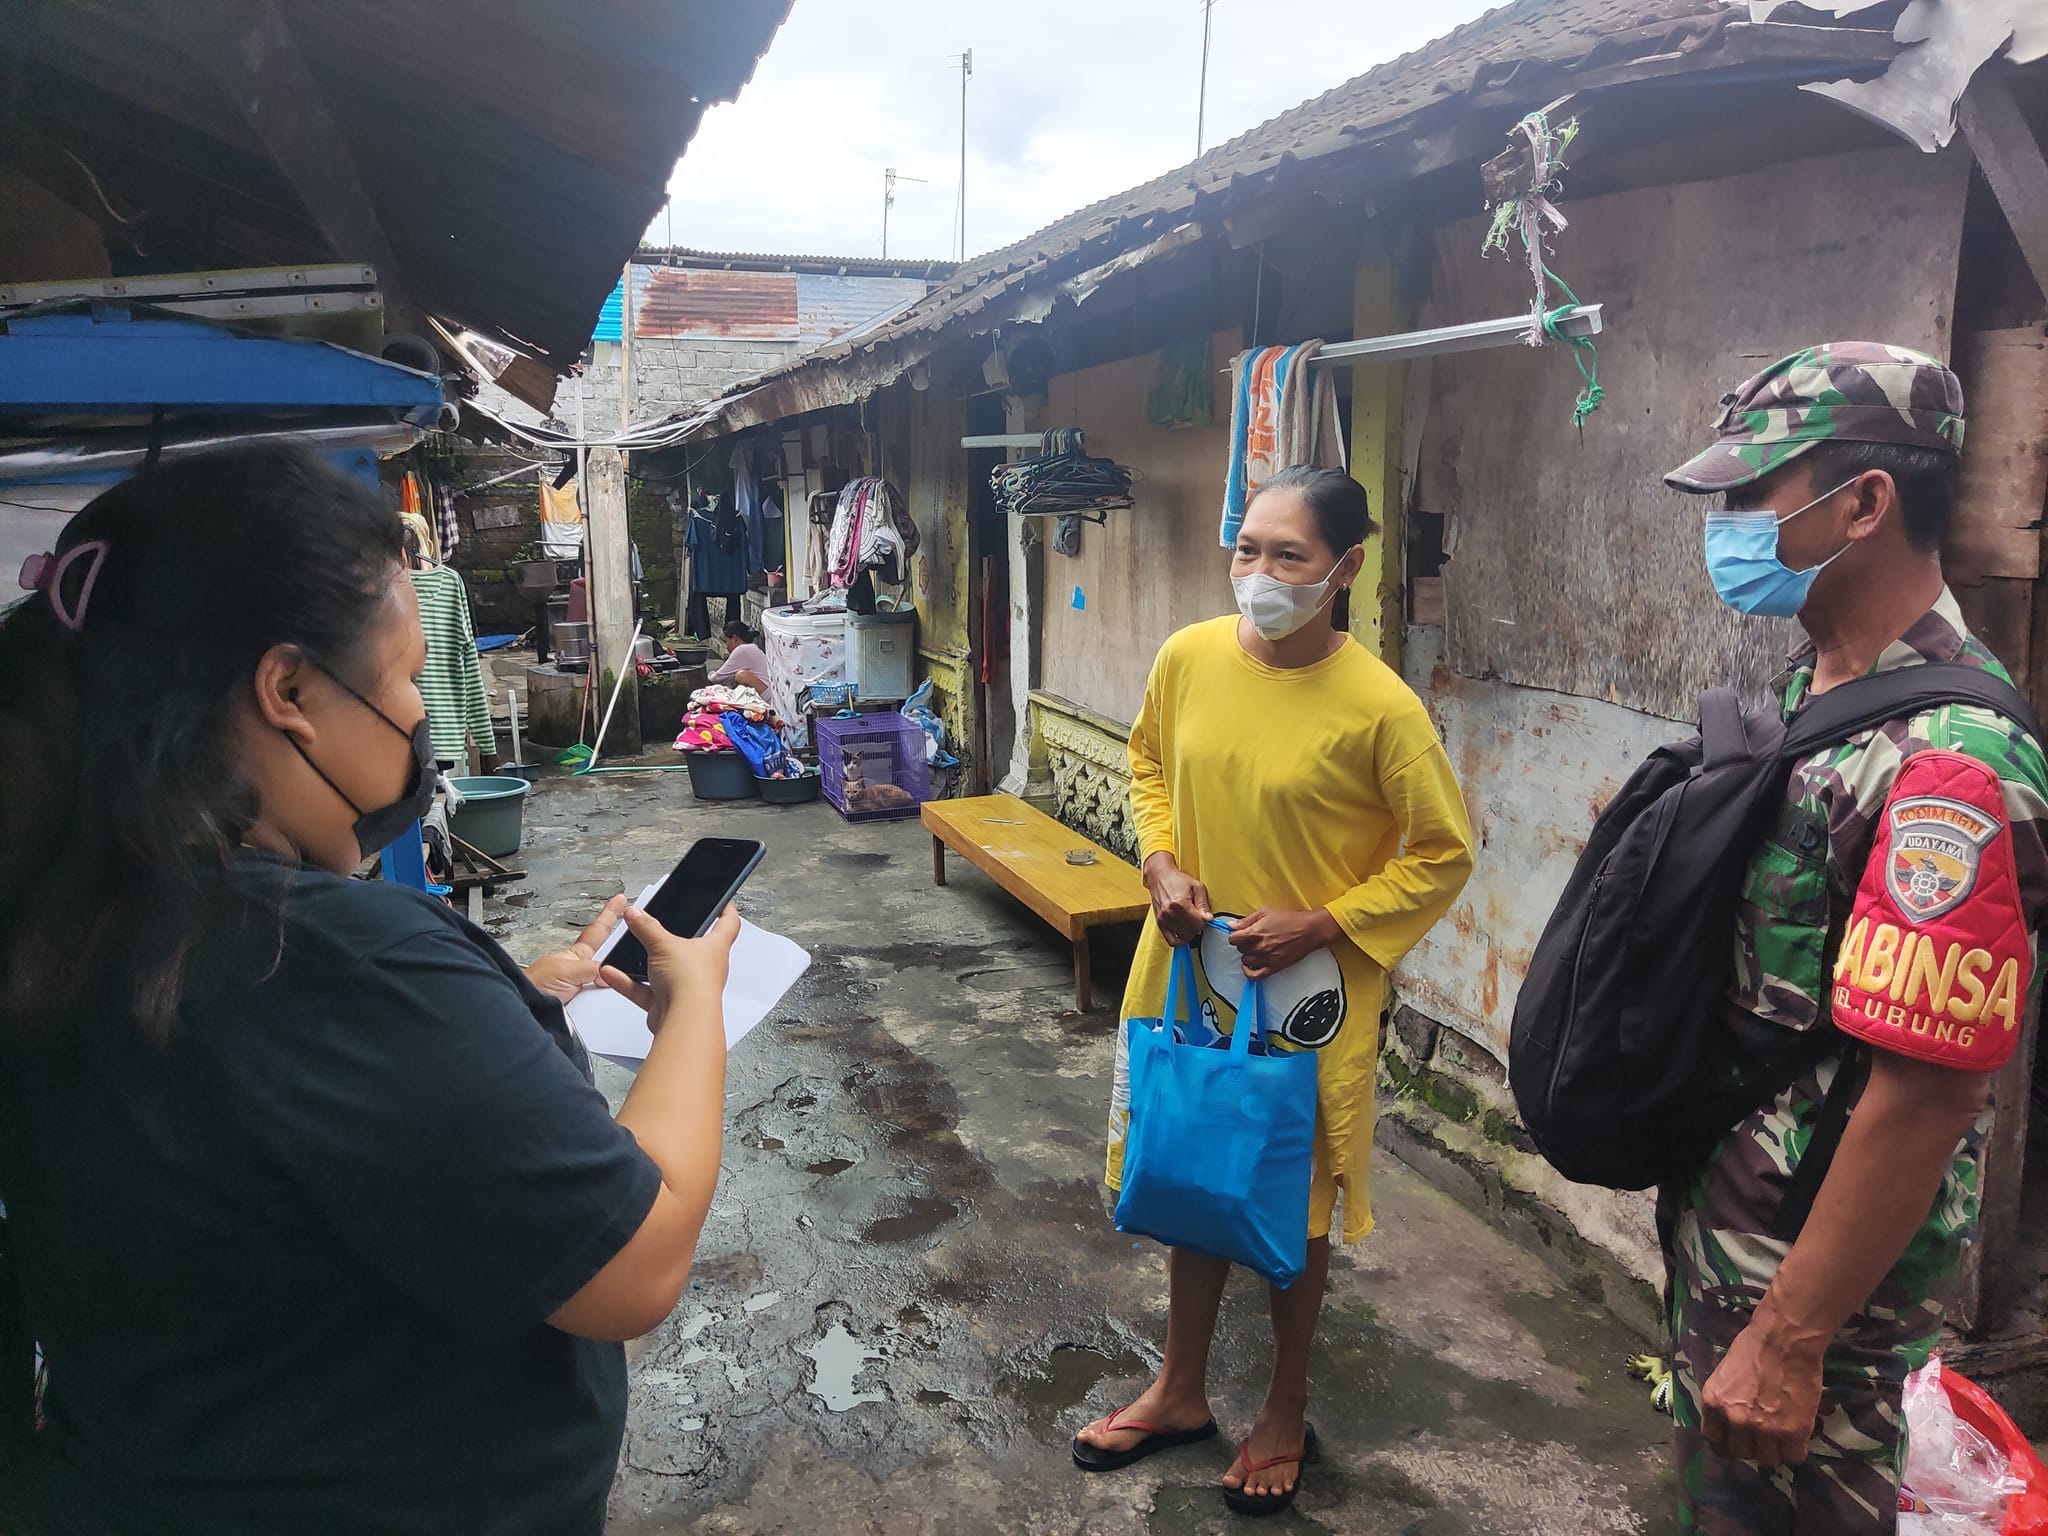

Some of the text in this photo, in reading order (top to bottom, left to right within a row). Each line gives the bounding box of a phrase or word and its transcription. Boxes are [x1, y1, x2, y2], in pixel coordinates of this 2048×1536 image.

[1897, 806, 1946, 825] KODIM
[1907, 836, 1963, 858] UDAYANA
[1833, 914, 2018, 1031] ABINSA
[1864, 998, 1976, 1048] UBUNG
